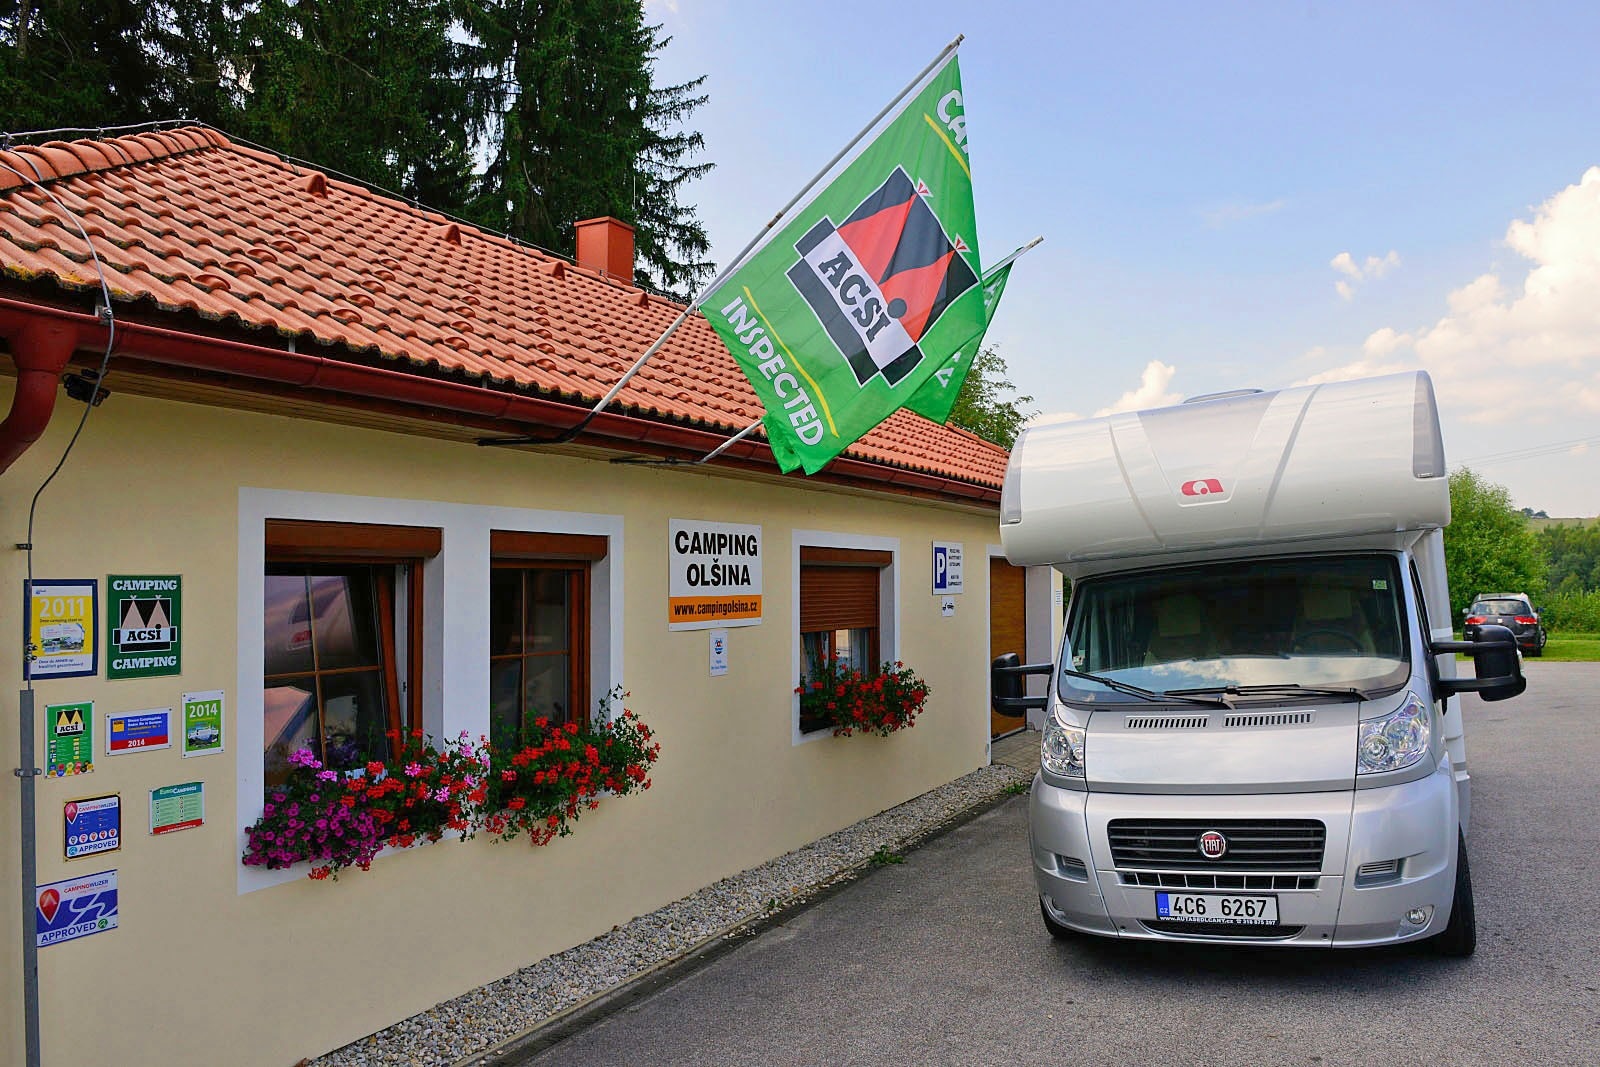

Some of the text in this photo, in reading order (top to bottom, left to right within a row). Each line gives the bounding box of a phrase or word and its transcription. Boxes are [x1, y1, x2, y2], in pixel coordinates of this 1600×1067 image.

[720, 296, 825, 446] INSPECTED
[674, 530, 758, 557] CAMPING
[686, 557, 752, 587] OLŠINA
[936, 552, 946, 584] P
[112, 579, 178, 591] CAMPING
[39, 598, 85, 617] 2011
[674, 600, 758, 616] www.campingolsina.cz
[112, 656, 177, 670] CAMPING
[189, 703, 218, 718] 2014
[127, 739, 145, 748] 2014
[79, 840, 117, 853] APPROVED
[1205, 840, 1220, 851] FIAT
[1174, 896, 1267, 917] 4C6 6267
[41, 922, 97, 943] APPROVED
